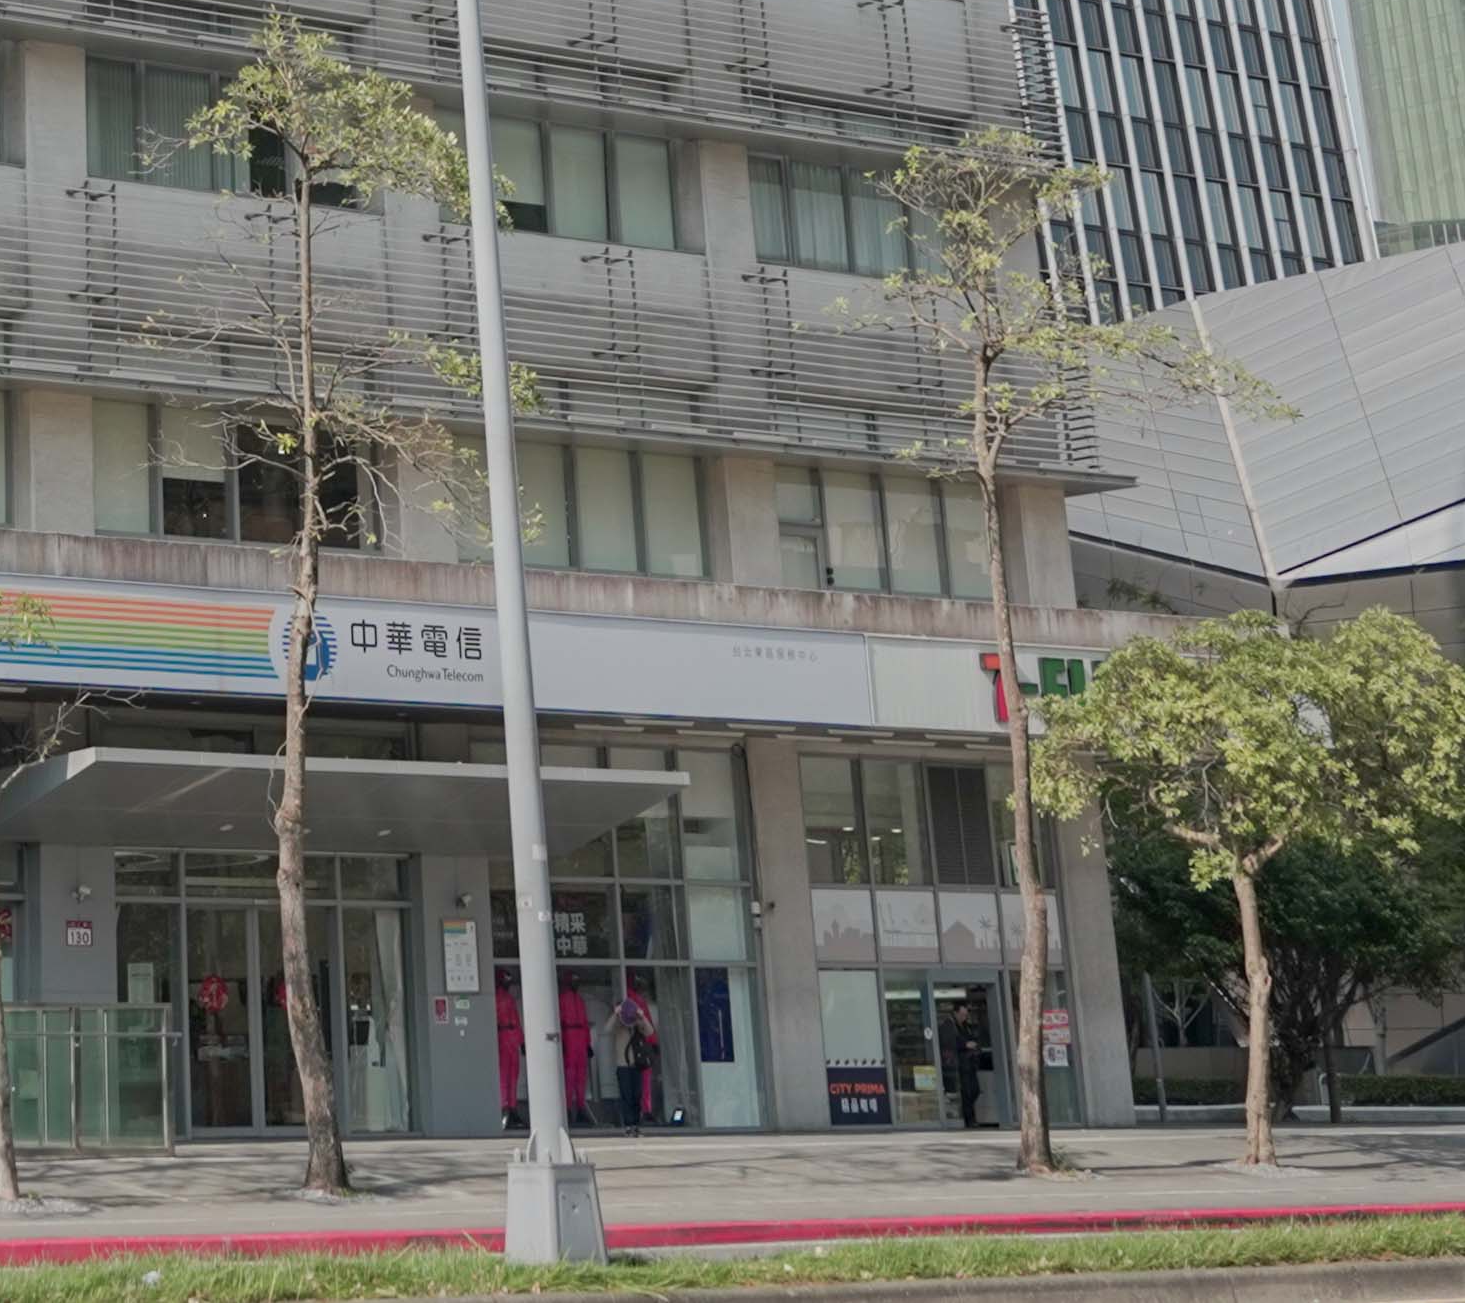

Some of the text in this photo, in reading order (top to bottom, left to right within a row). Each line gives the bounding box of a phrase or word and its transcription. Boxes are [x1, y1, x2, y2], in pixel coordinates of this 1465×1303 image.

[350, 619, 483, 661] 中華電信
[386, 664, 484, 683] Chunghwa Telecom
[70, 931, 89, 944] 130
[556, 935, 588, 956] 中華
[829, 1082, 886, 1095] CITY PRIMA
